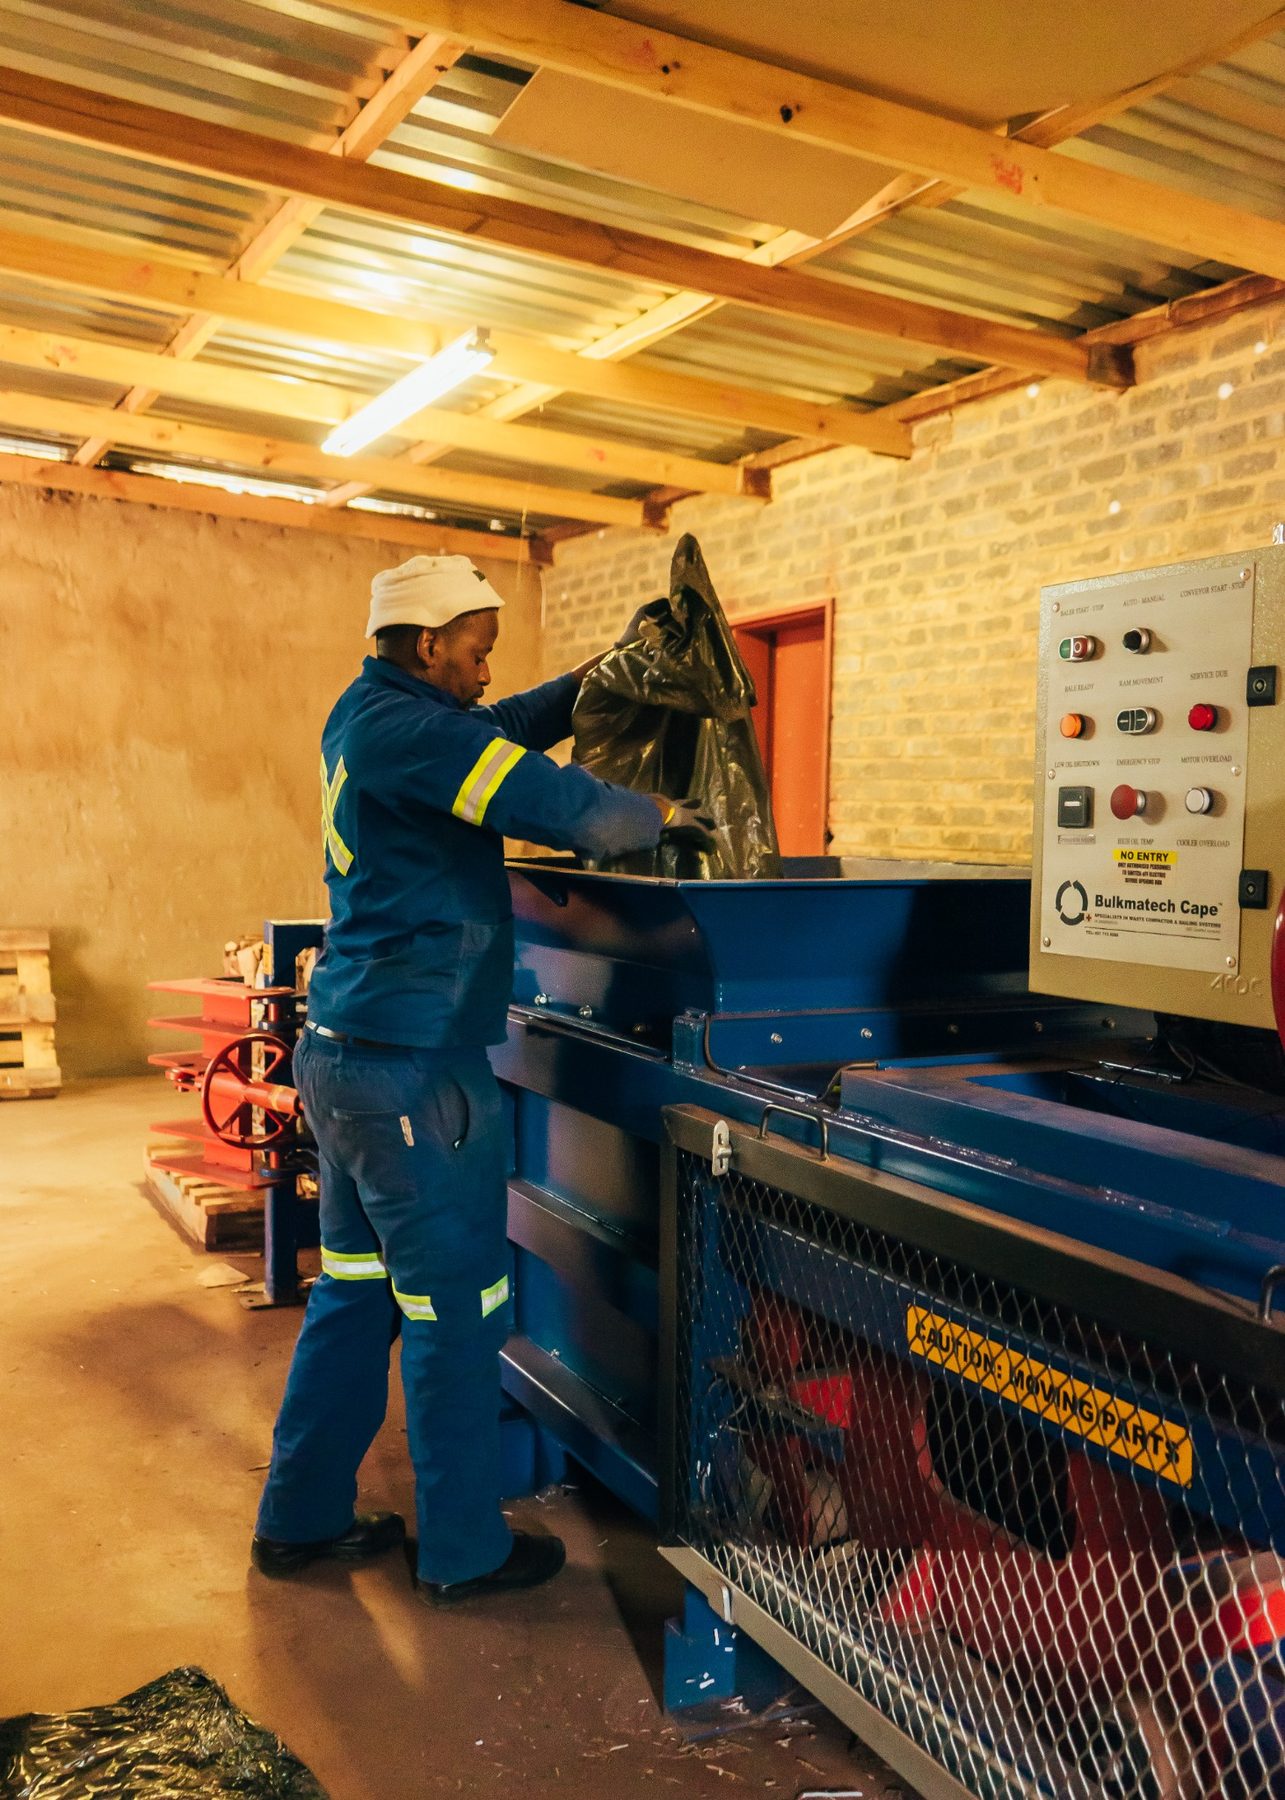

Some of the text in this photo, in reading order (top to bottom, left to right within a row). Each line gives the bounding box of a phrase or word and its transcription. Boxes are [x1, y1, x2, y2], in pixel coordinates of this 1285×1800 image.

[1180, 586, 1210, 598] CONVEYOR
[1211, 583, 1228, 593] START
[1232, 581, 1247, 590] STOP
[1122, 598, 1138, 608] AUTO
[1141, 594, 1166, 604] MANUAL
[1076, 606, 1090, 614] START
[1092, 604, 1104, 612] STOP
[1190, 670, 1228, 680] SERVICE DUE
[1119, 676, 1164, 687] RAM MOVEMENT
[1064, 683, 1094, 692] BALE READY
[1116, 758, 1160, 766] EMERGENCY STOP
[1200, 755, 1232, 764] OVERLOAD
[1176, 839, 1230, 848] COOLER OVERLOAD
[1120, 851, 1168, 862] NO ENTRY
[1095, 894, 1218, 918] Bulkmatech Cape
[916, 1322, 1180, 1465] CAUTION: MOVING PARTS
